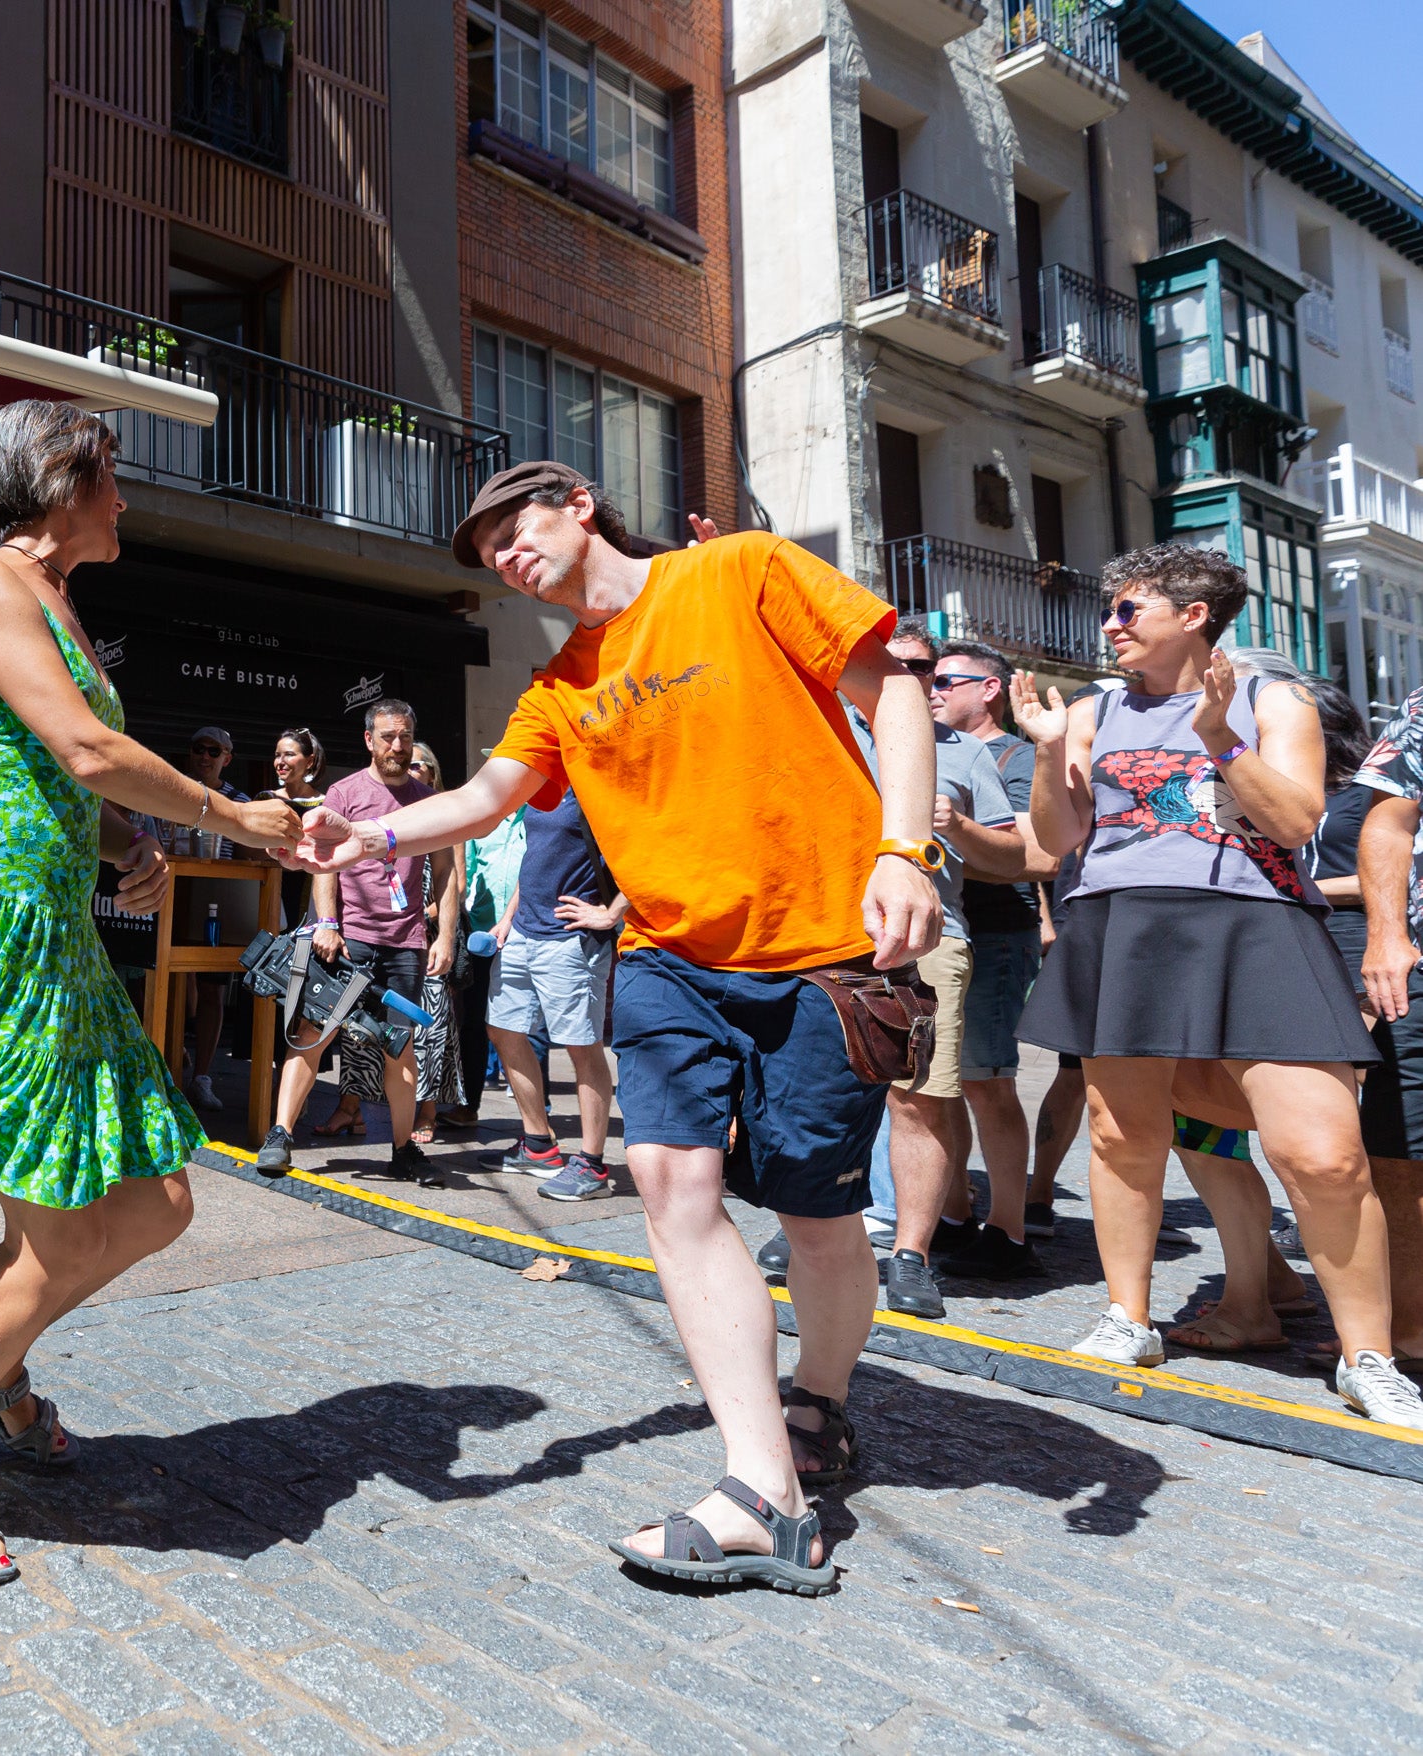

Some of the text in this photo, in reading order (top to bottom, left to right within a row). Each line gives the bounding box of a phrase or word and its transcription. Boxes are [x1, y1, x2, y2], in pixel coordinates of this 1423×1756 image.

[218, 628, 280, 648] gin club
[181, 663, 297, 690] CAFÉ BISTRÓ
[345, 680, 384, 707] Schweppes
[111, 920, 153, 932] COMIDAS
[312, 983, 323, 994] 6
